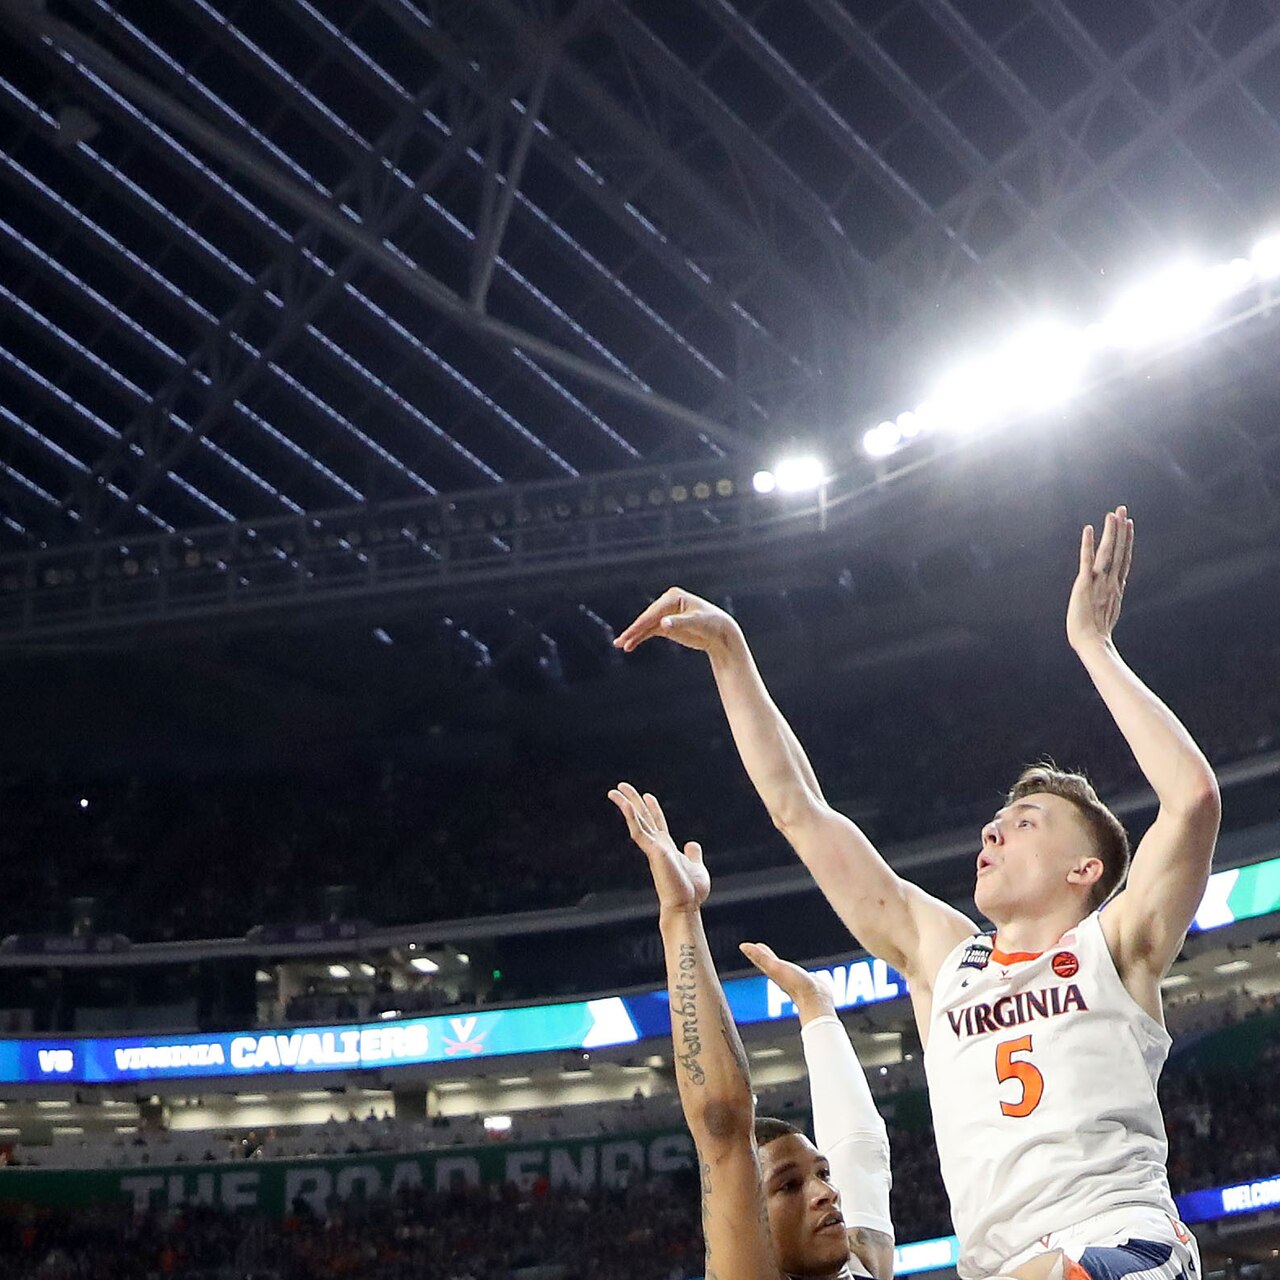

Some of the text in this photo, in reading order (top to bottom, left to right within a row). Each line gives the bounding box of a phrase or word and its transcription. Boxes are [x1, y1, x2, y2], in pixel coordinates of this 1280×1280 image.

[767, 958, 899, 1018] FNAL
[946, 983, 1090, 1042] VIRGINIA
[38, 1049, 74, 1073] VS
[115, 1043, 225, 1070] VIRGINIA
[229, 1023, 429, 1069] CAVALIERS
[994, 1034, 1045, 1118] 5
[120, 1133, 693, 1213] THE ROAD ENDS
